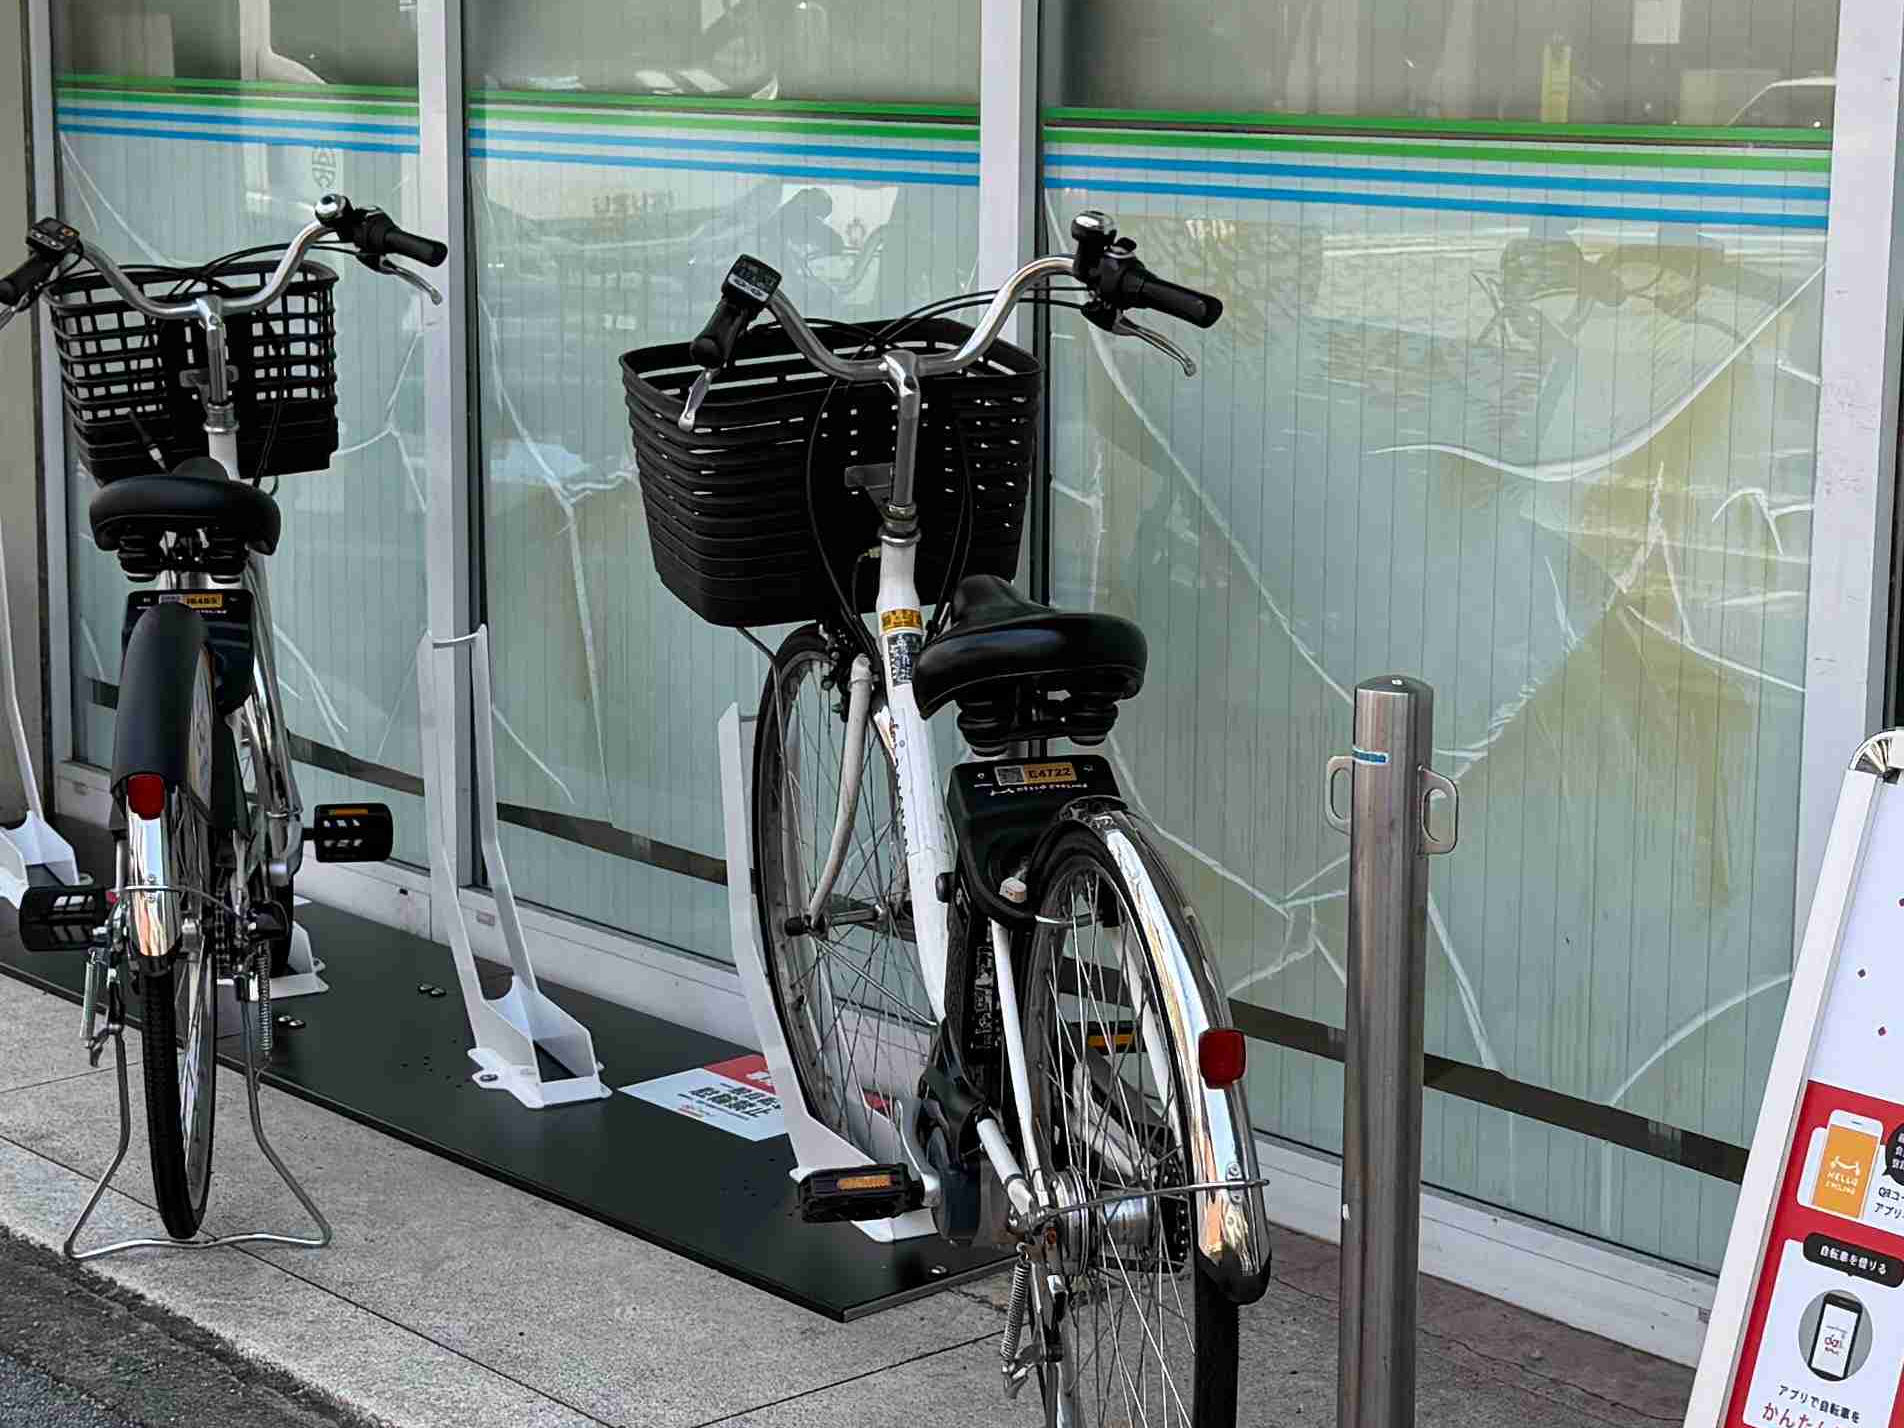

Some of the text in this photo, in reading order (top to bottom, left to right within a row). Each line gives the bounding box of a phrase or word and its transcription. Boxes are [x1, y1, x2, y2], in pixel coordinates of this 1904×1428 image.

[1778, 1384, 1861, 1425] アプリで自転車を
